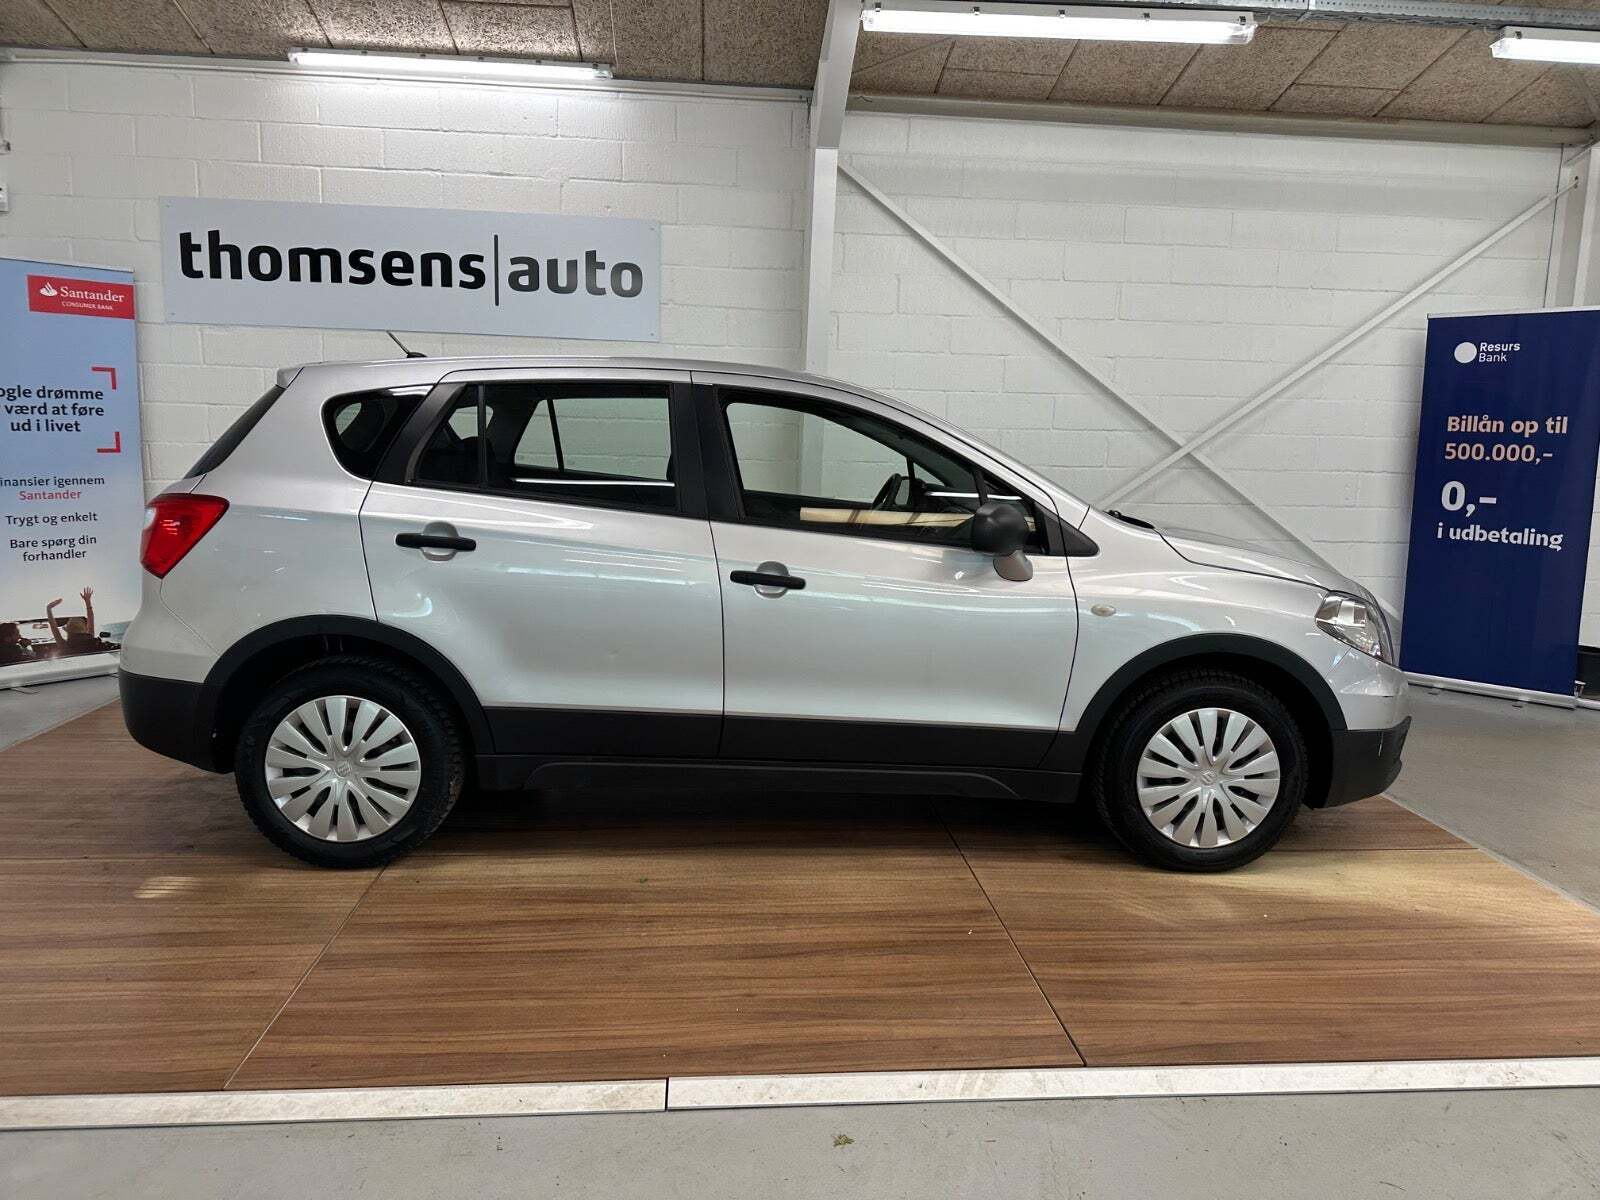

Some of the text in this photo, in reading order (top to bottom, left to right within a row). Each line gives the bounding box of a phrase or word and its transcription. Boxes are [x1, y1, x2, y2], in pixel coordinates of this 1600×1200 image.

[179, 229, 643, 298] thomsens auto
[60, 286, 125, 302] Santander
[1479, 342, 1521, 352] Resurs
[1478, 352, 1508, 362] Bank
[36, 385, 104, 400] drømme
[4, 402, 105, 416] værd at føre
[10, 418, 81, 432] ud i livet
[1447, 414, 1568, 438] Billån op til
[53, 476, 105, 489] igennem
[19, 489, 82, 501] Santander
[5, 511, 98, 527] Trygt og enkelt
[10, 534, 97, 549] Bare spørg din
[1437, 521, 1564, 552] i udbetaling
[22, 549, 88, 562] forhandler
